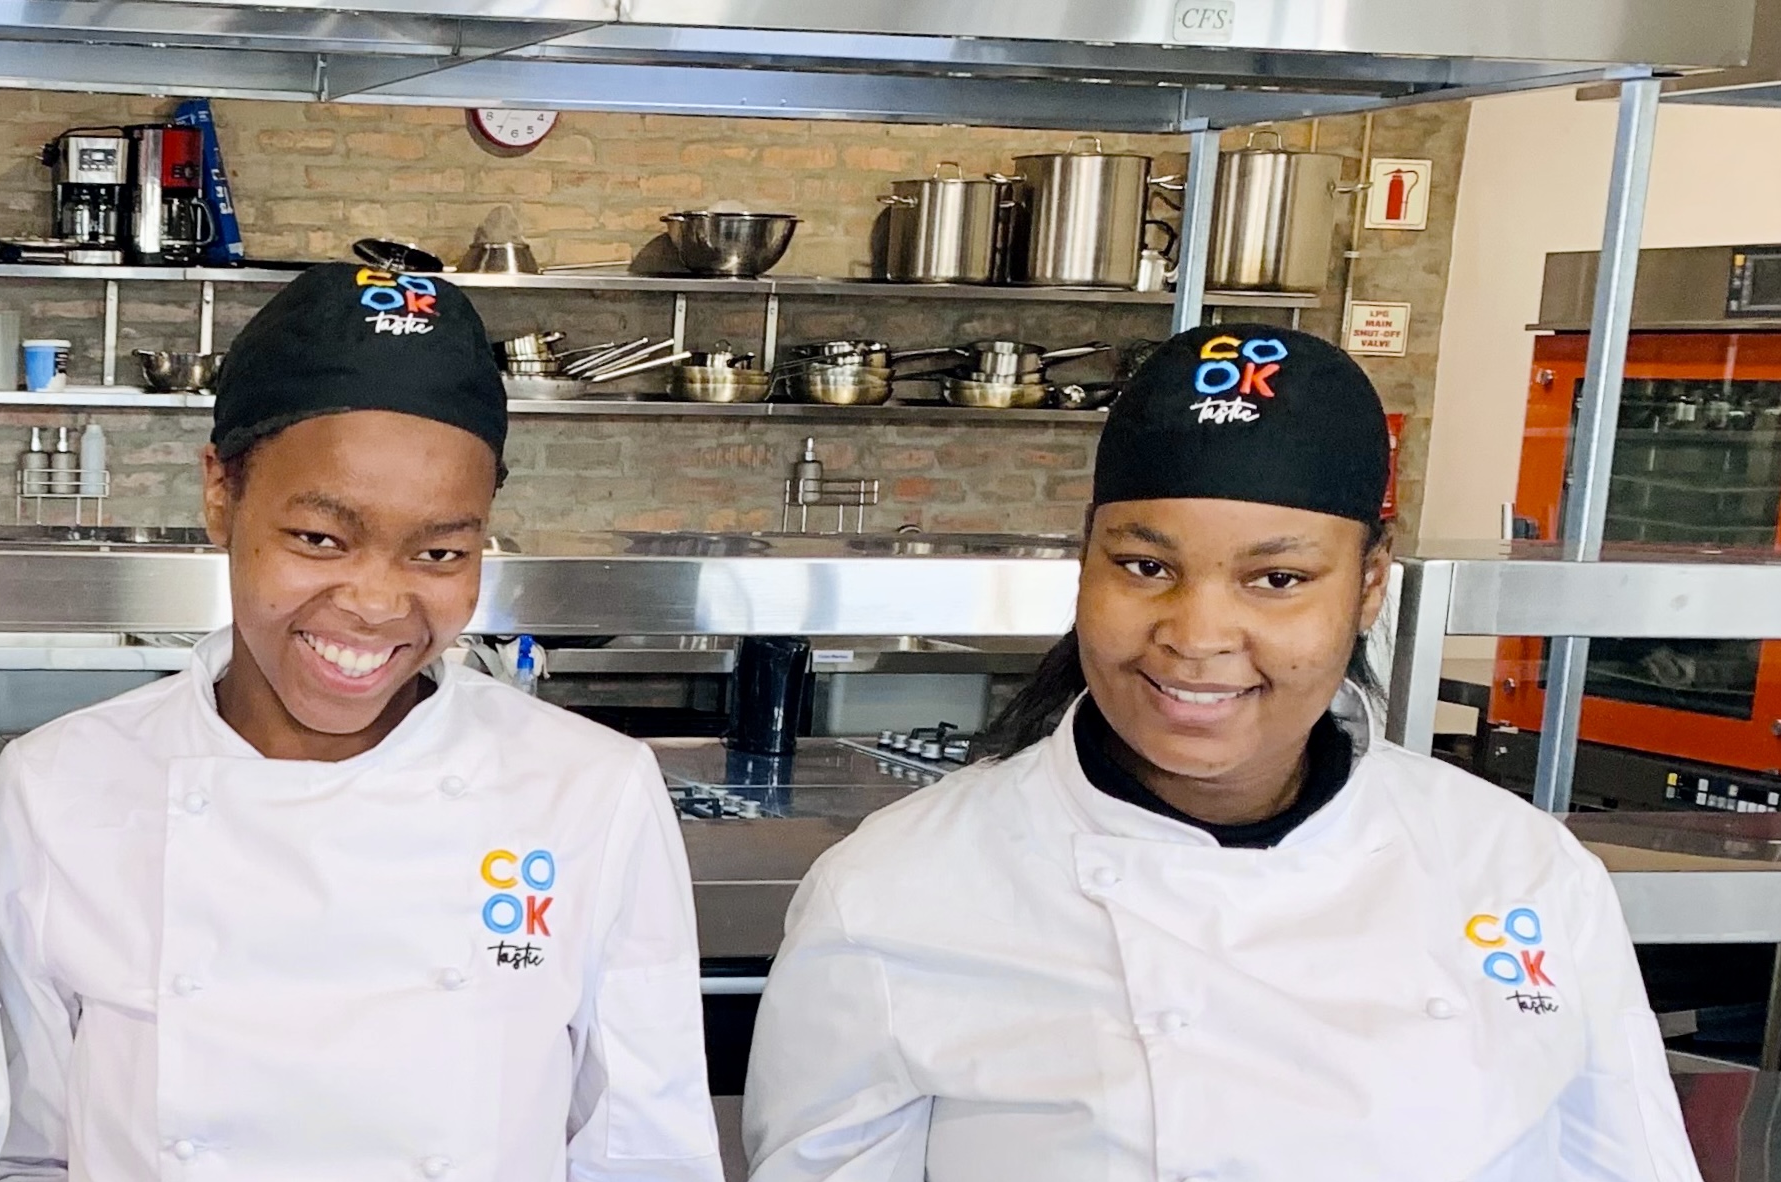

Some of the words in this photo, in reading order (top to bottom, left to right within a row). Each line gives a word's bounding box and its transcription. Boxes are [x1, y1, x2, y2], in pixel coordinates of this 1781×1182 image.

[1182, 7, 1228, 29] CFS
[536, 113, 545, 122] 4
[496, 125, 504, 134] 7
[510, 129, 519, 138] 6
[526, 125, 534, 135] 5
[1365, 320, 1393, 328] MAIN
[1361, 340, 1391, 348] VALVE
